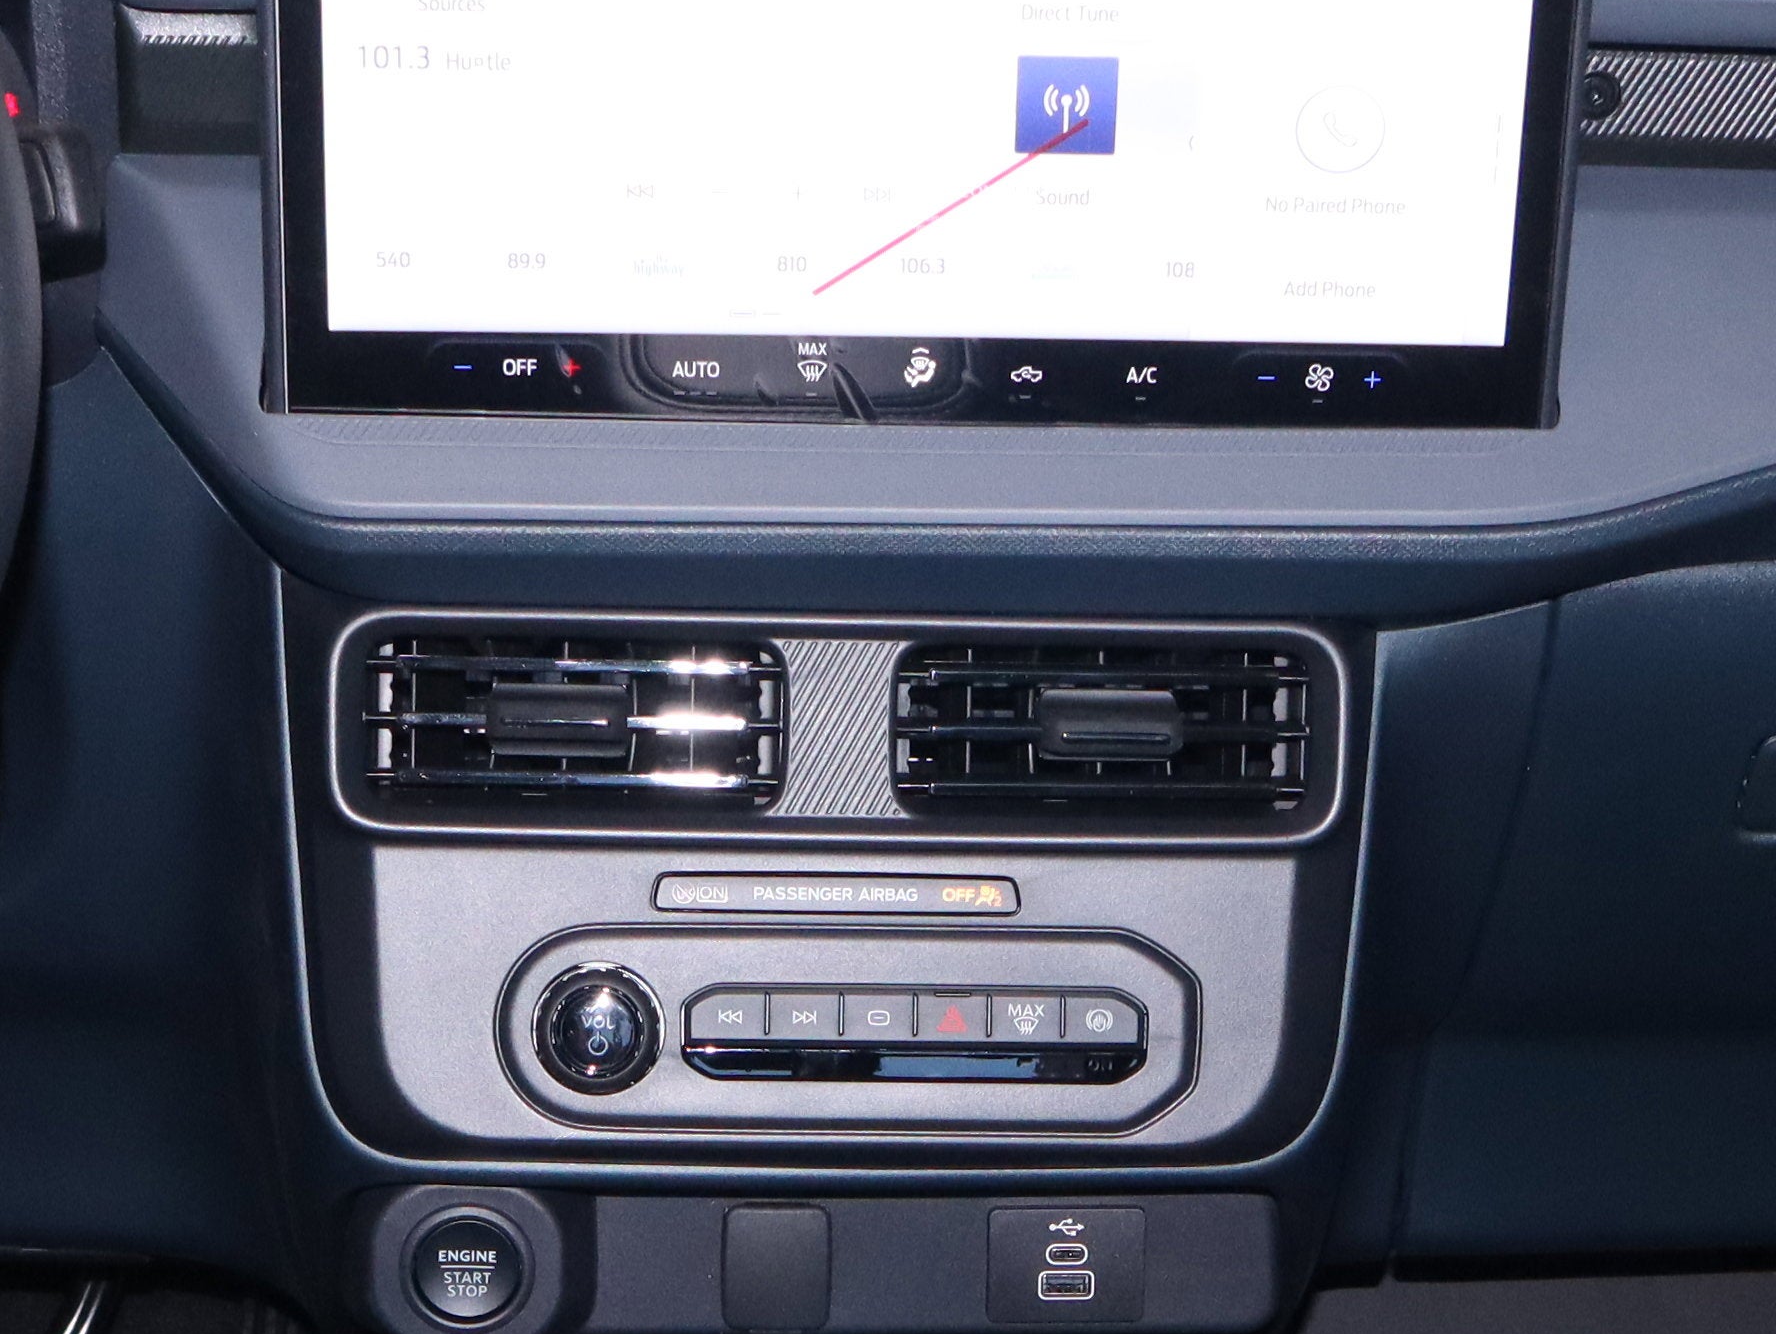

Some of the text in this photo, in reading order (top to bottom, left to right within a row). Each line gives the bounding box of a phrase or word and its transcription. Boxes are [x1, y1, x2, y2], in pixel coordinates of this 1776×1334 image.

[1020, 3, 1120, 24] Direct Tune
[357, 43, 431, 71] 101.3
[1036, 187, 1090, 207] Sound
[1265, 196, 1407, 215] No Paired Phone
[376, 250, 411, 269] 540
[507, 251, 547, 270] 89.9
[776, 254, 807, 273] 810
[898, 257, 946, 276] 106.3
[1284, 280, 1377, 299] Add Phone
[797, 342, 828, 356] MAX
[503, 358, 537, 377] OFF
[672, 360, 720, 378] AUTO
[1126, 366, 1158, 385] A/C
[700, 887, 724, 901] ON
[753, 886, 919, 902] PASSENGER AIRBAG
[942, 887, 976, 903] OFF
[1008, 1003, 1045, 1017] MAX
[581, 1014, 616, 1030] VOL
[438, 1250, 497, 1264] ENGINE
[444, 1271, 491, 1284] START
[447, 1285, 488, 1297] STOP
